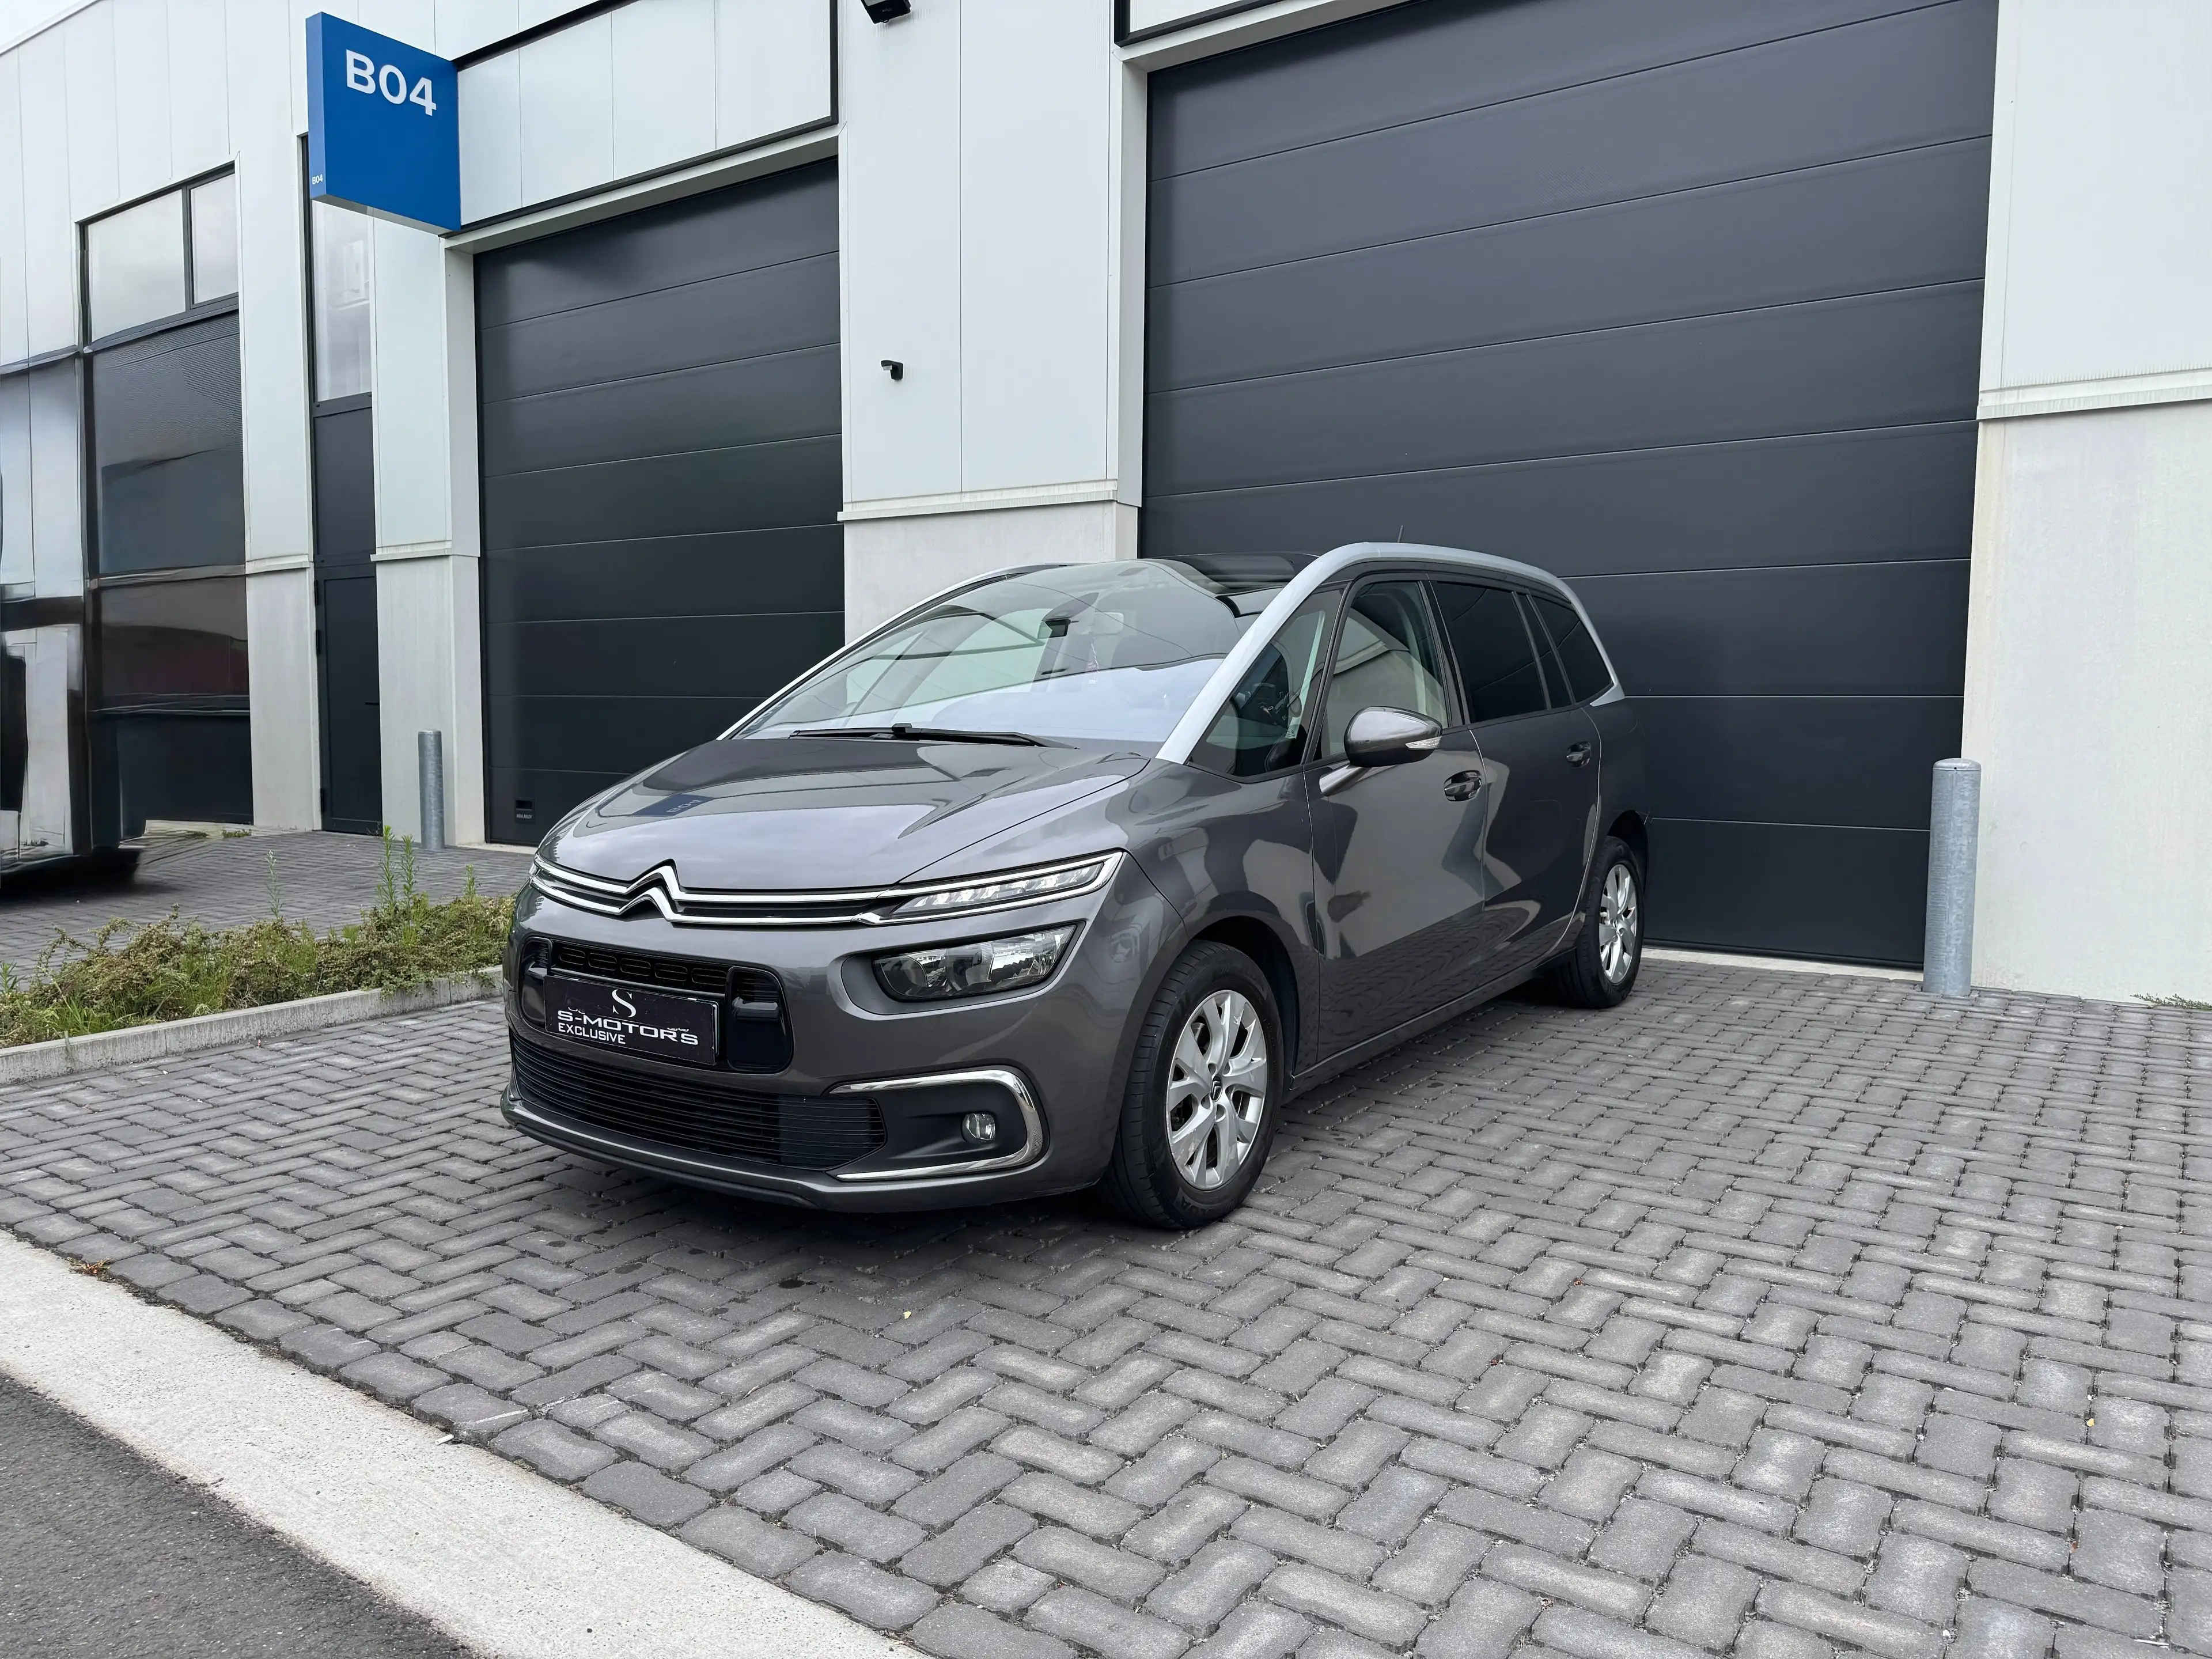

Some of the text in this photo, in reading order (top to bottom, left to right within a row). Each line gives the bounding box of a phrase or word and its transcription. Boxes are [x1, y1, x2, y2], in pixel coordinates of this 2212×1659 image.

[346, 49, 437, 116] B04
[312, 174, 323, 185] B04
[558, 1010, 698, 1046] S-MOTORS
[558, 1022, 626, 1045] EXCLUSIVE
